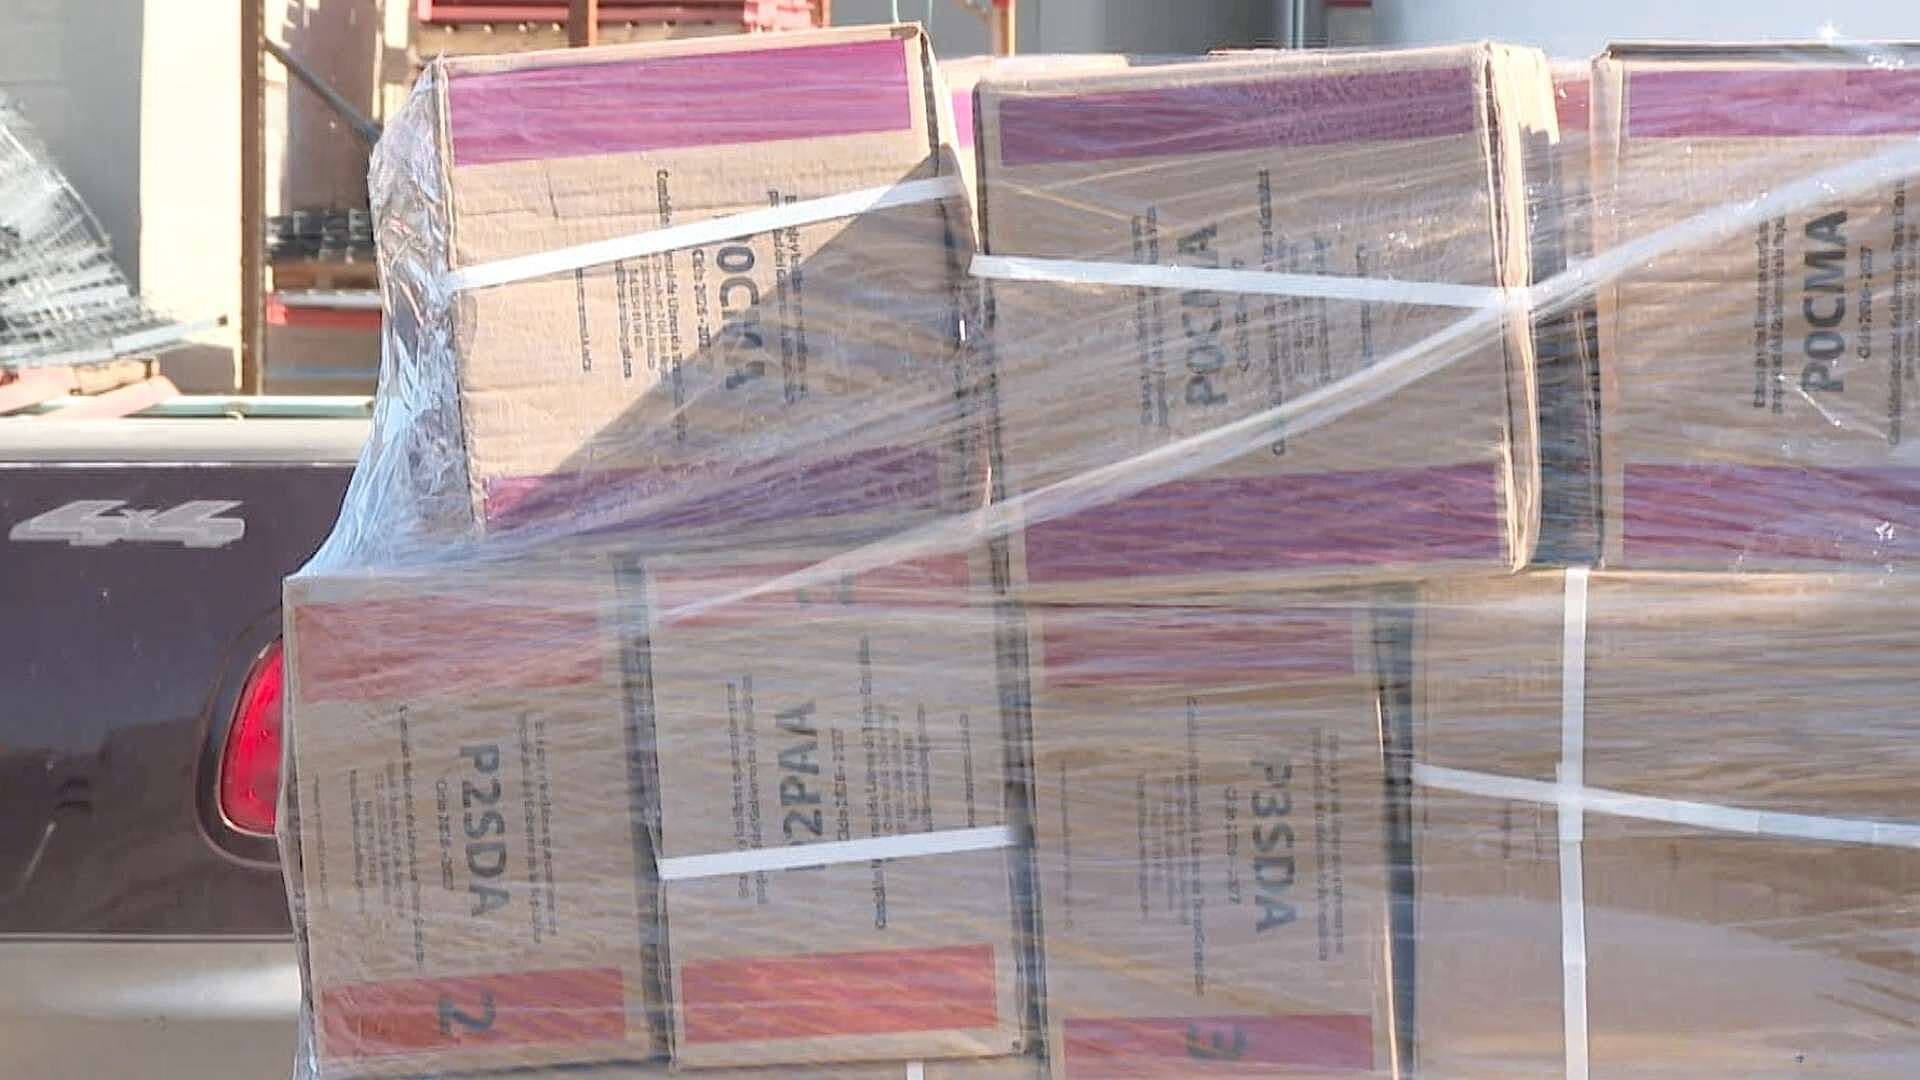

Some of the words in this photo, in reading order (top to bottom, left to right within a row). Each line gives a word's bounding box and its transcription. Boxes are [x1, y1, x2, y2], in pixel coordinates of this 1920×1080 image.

[459, 744, 511, 918] P2SDA
[1250, 760, 1297, 935] P3SDA
[438, 990, 498, 1034] 2
